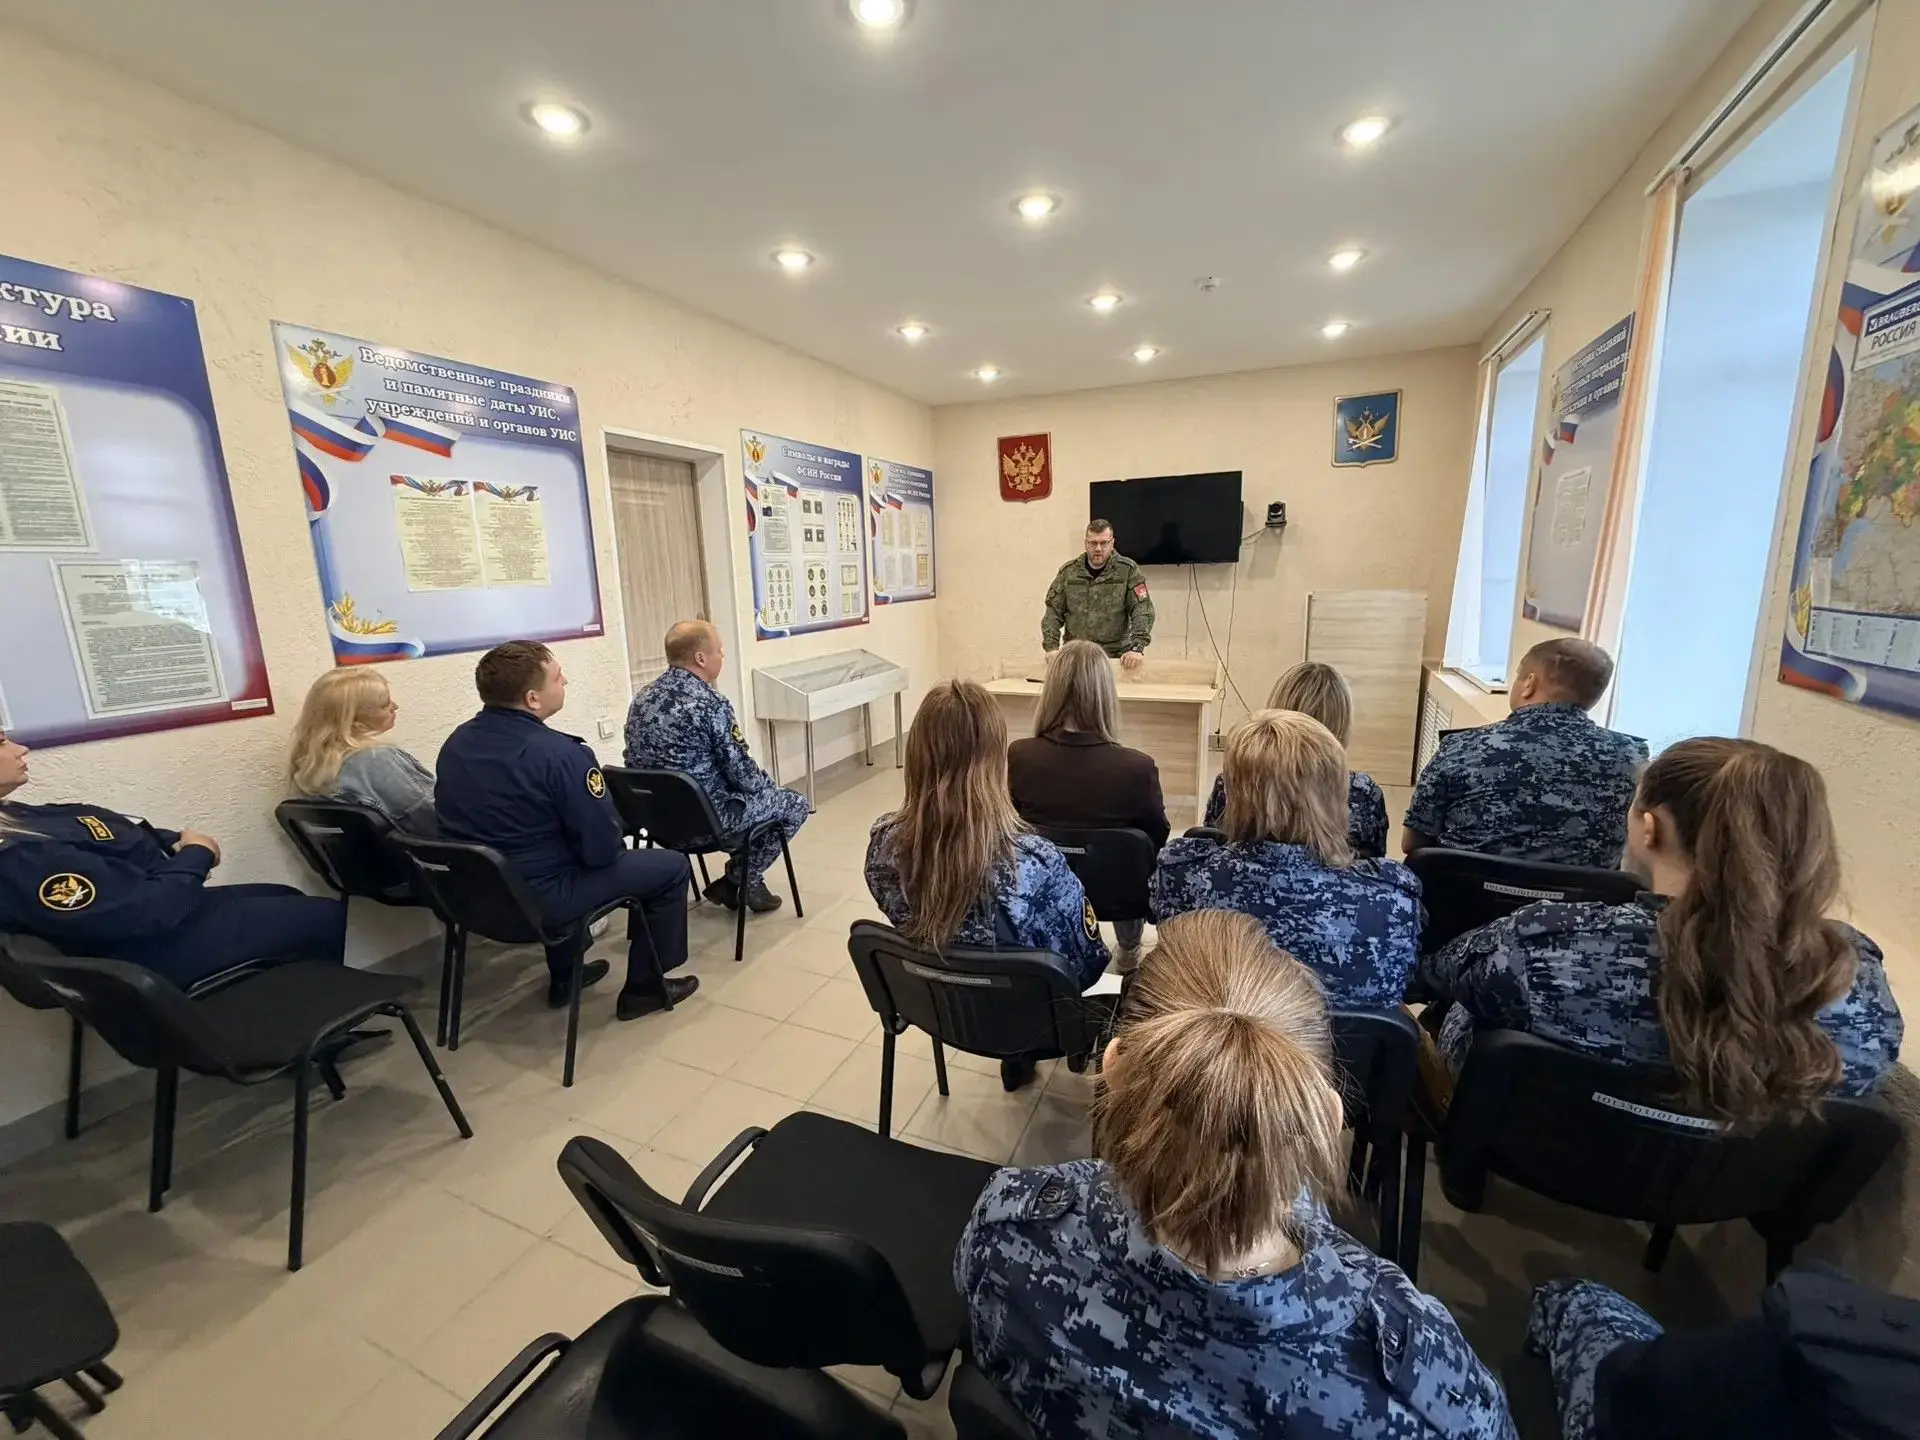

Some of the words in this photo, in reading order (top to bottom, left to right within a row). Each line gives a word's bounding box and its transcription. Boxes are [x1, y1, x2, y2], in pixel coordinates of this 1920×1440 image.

[0, 324, 63, 351] ии
[1871, 321, 1916, 350] РОССИЯ
[360, 346, 496, 388] Ведомственные
[499, 380, 571, 404] праздники
[384, 379, 399, 392] и
[402, 382, 486, 407] памятные
[490, 399, 526, 415] даты
[528, 403, 561, 422] УИС,
[366, 399, 476, 427] учреждений
[479, 417, 490, 429] и
[493, 420, 548, 438] органов
[550, 427, 577, 442] УИС
[782, 446, 816, 461] Символы
[796, 465, 818, 478] ФСИН
[819, 470, 842, 482] России
